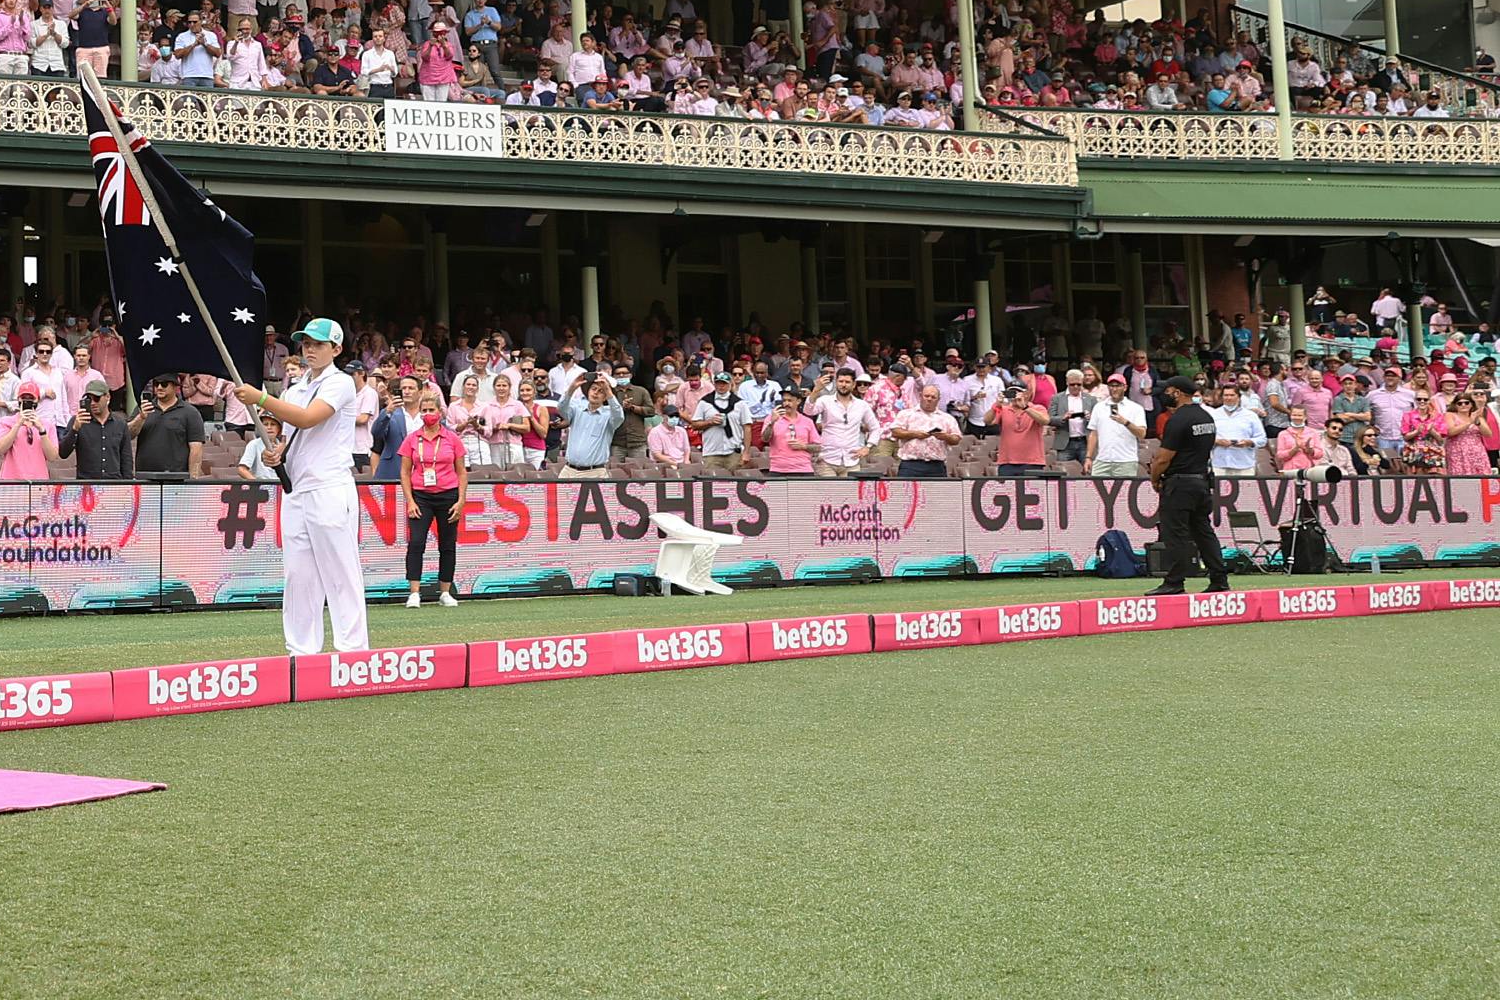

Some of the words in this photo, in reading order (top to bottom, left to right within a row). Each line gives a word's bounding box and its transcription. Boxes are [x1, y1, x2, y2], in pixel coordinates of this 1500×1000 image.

[392, 107, 495, 129] MEMBERS
[396, 131, 493, 152] PAVILION
[819, 504, 882, 523] McGrath
[1090, 480, 1240, 529] YOR
[1189, 593, 1246, 618] bet365
[1278, 590, 1336, 613] bet365
[1369, 585, 1420, 608] bet365
[895, 612, 962, 640] bet365
[998, 606, 1062, 634] bet365
[1097, 599, 1157, 625] bet365
[637, 629, 723, 662] bet365
[772, 619, 848, 650] bet365
[330, 649, 435, 687] bet365
[497, 638, 588, 672] bet365
[148, 662, 258, 704] bet365
